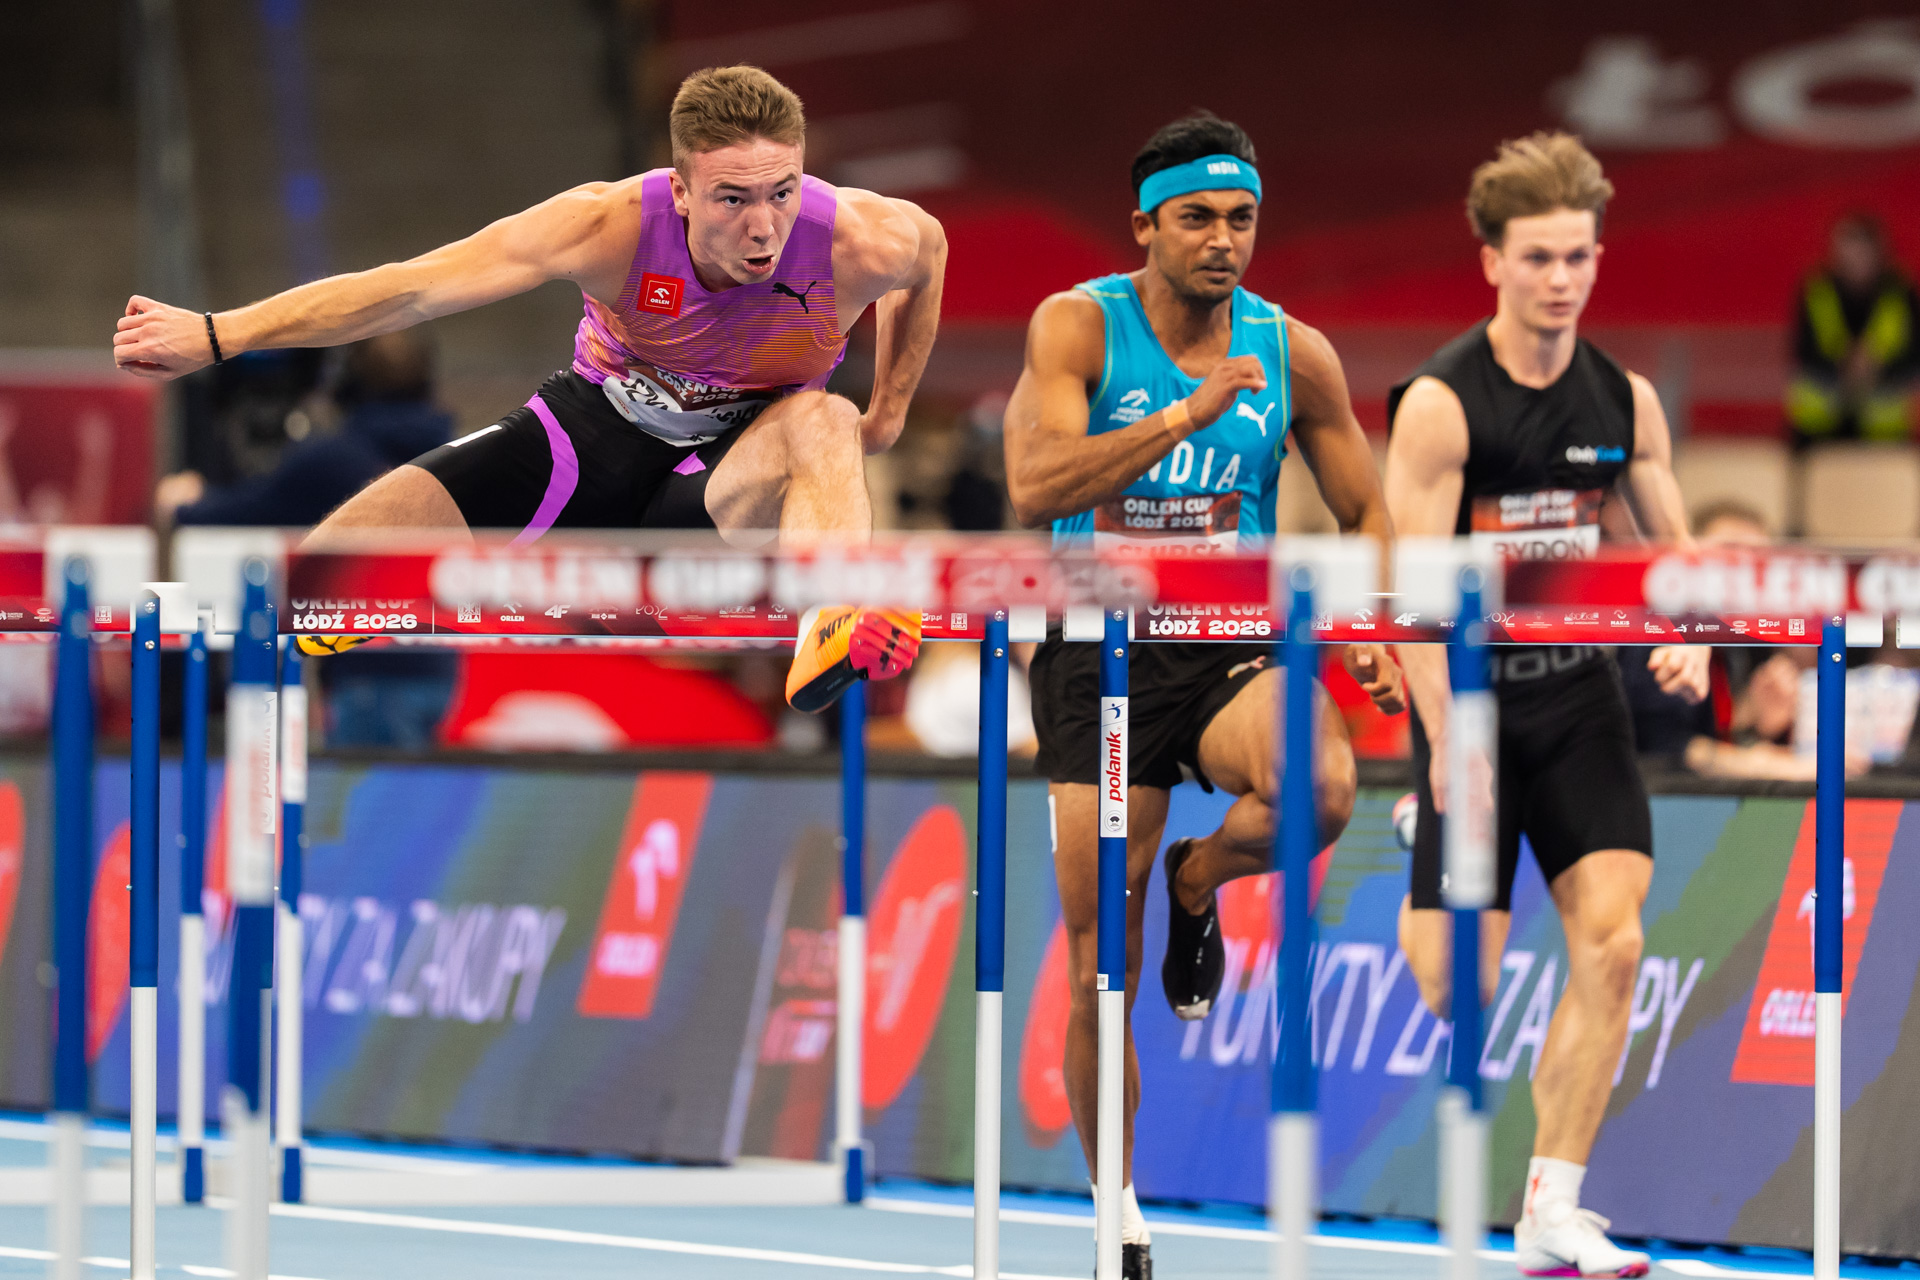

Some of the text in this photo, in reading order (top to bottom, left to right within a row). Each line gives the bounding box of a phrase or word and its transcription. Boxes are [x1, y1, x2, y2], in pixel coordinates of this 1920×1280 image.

[1207, 161, 1241, 175] INDIA
[650, 298, 670, 306] ORLEN
[1124, 497, 1214, 514] ORLEN CUP
[1169, 513, 1214, 528] 2026
[291, 597, 416, 610] ORLEN CUP
[1147, 604, 1270, 616] ORLEN CUP
[544, 604, 571, 619] 4F
[293, 610, 418, 630] ŁÓDŹ 2026
[1149, 616, 1272, 636] ŁÓDŹ 2026
[1394, 612, 1421, 627] 4F
[1105, 730, 1124, 803] polanik
[1759, 987, 1816, 1037] ORLE
[1478, 950, 1706, 1090] ZAPY
